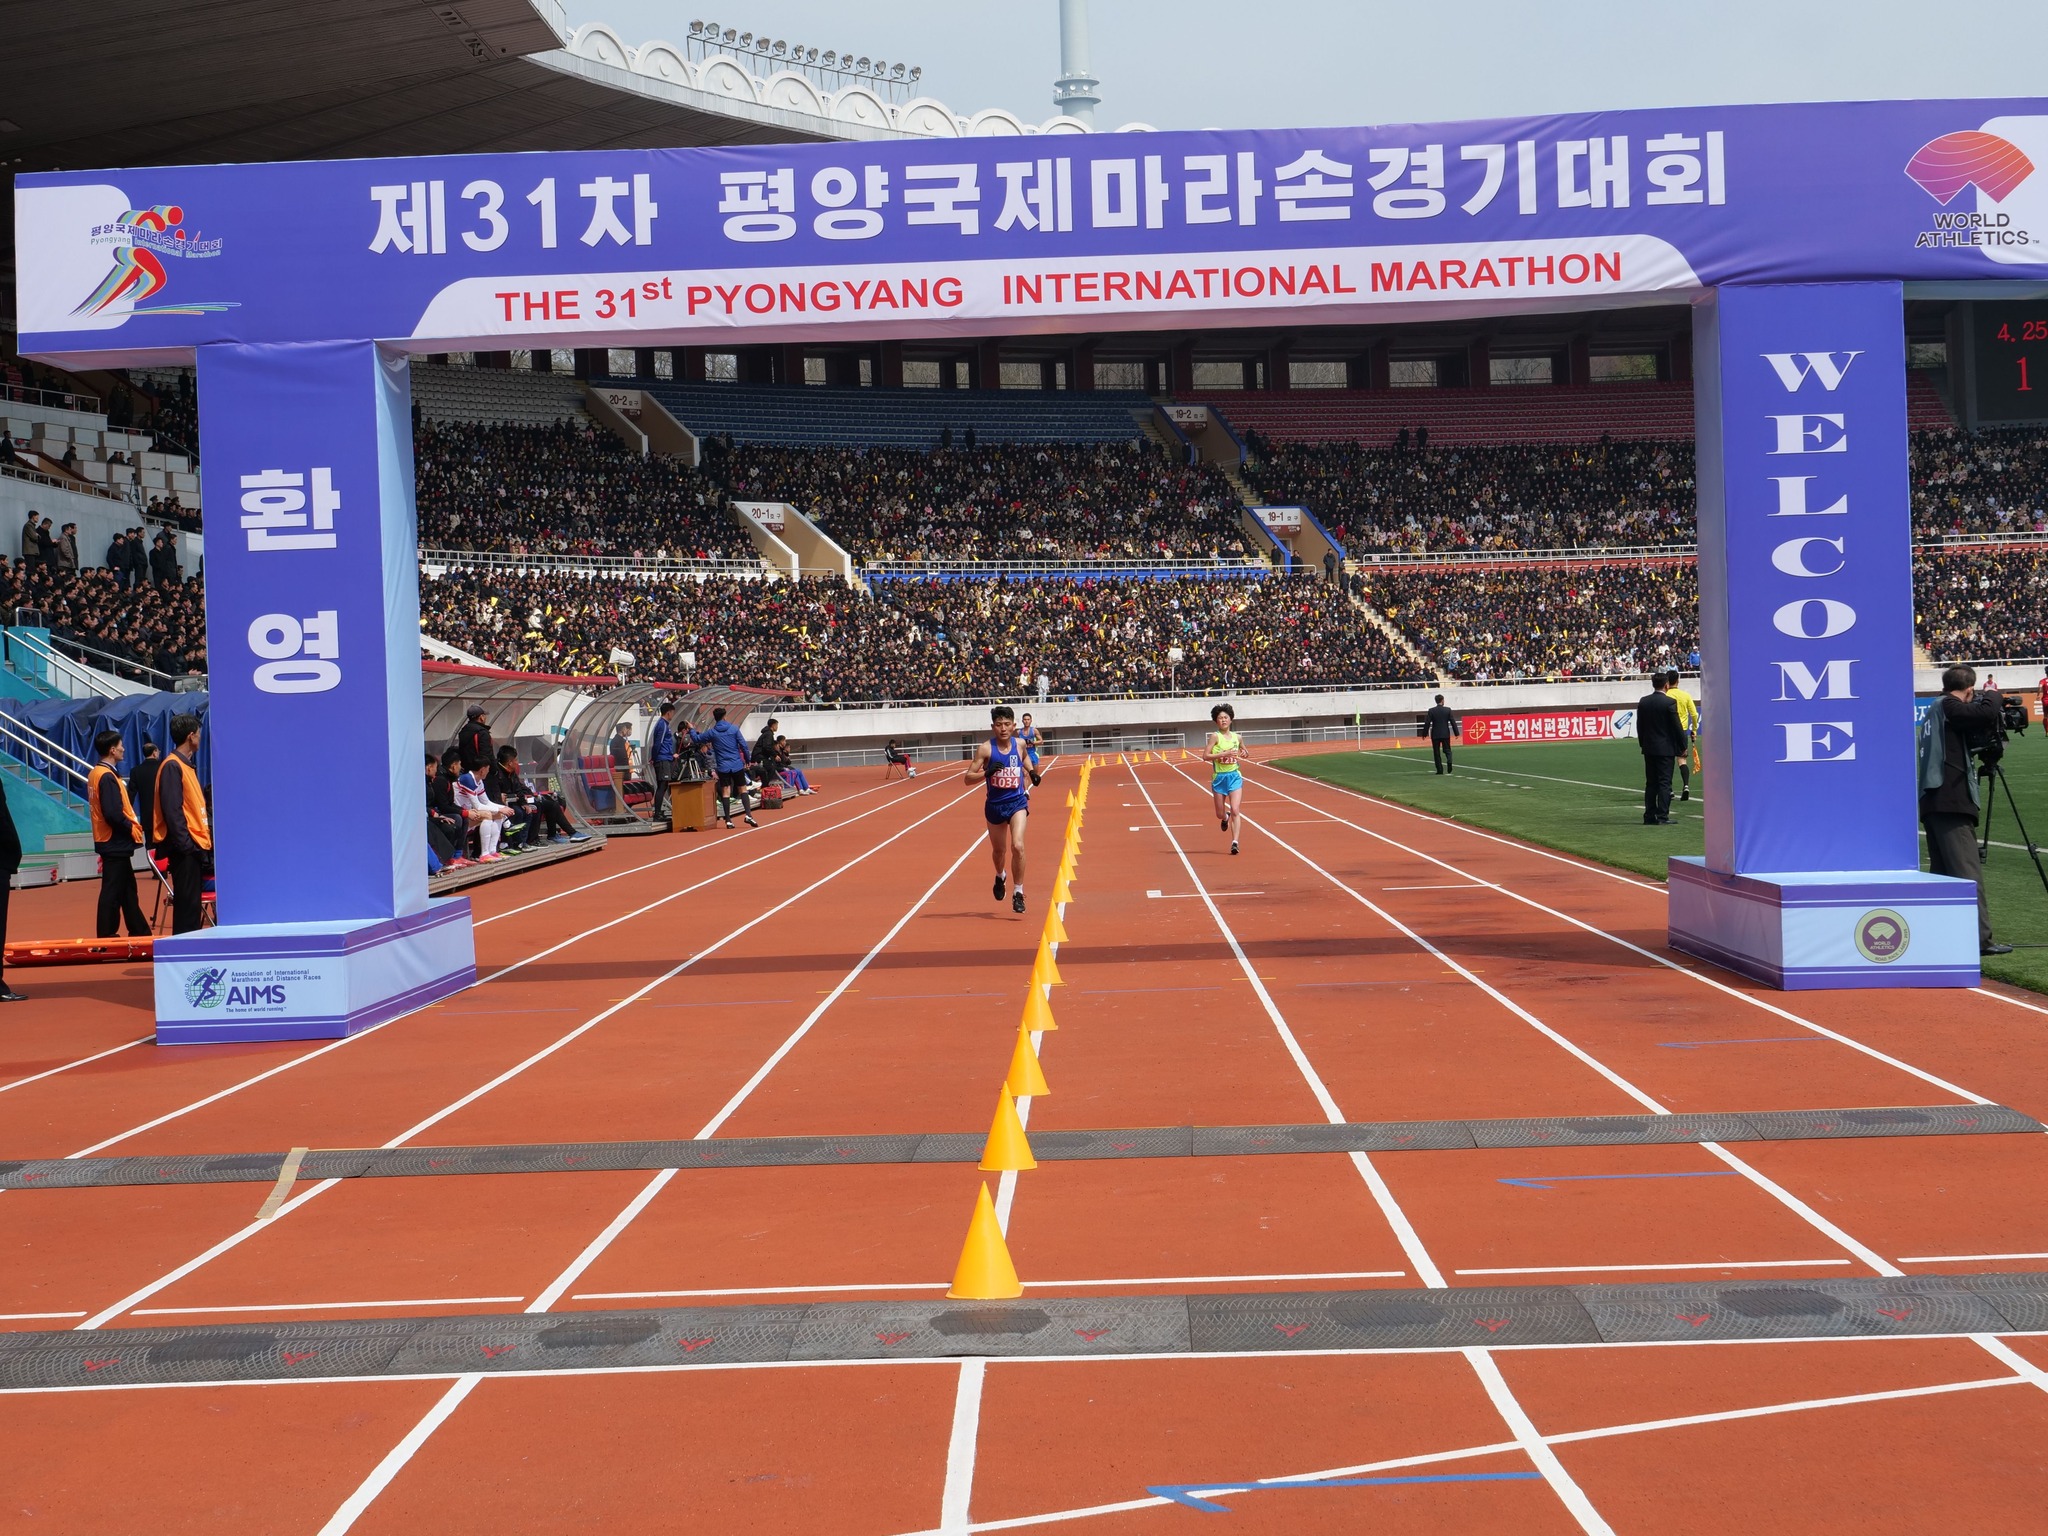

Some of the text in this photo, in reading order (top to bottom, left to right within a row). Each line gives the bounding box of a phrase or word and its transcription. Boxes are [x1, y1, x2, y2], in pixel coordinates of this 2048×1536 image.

[367, 131, 1727, 255] 제31차 평양국제마라손경기대회
[1932, 212, 2011, 230] WORLD
[90, 236, 131, 246] Pyongyang
[185, 249, 222, 259] Marathon
[1914, 230, 2030, 248] ATHLETICS
[494, 251, 1623, 323] THE 31st PYONGYANG INTERNATIONAL MARATHON
[609, 394, 628, 406] 20-2
[1175, 409, 1192, 419] 19-2
[751, 507, 770, 519] 20-1
[1267, 511, 1284, 521] 19-1
[1759, 350, 1867, 764] WELCOME
[1489, 715, 1612, 741] 근적외선편광치료기
[992, 777, 1020, 789] 1034
[226, 984, 287, 1005] AIMS
